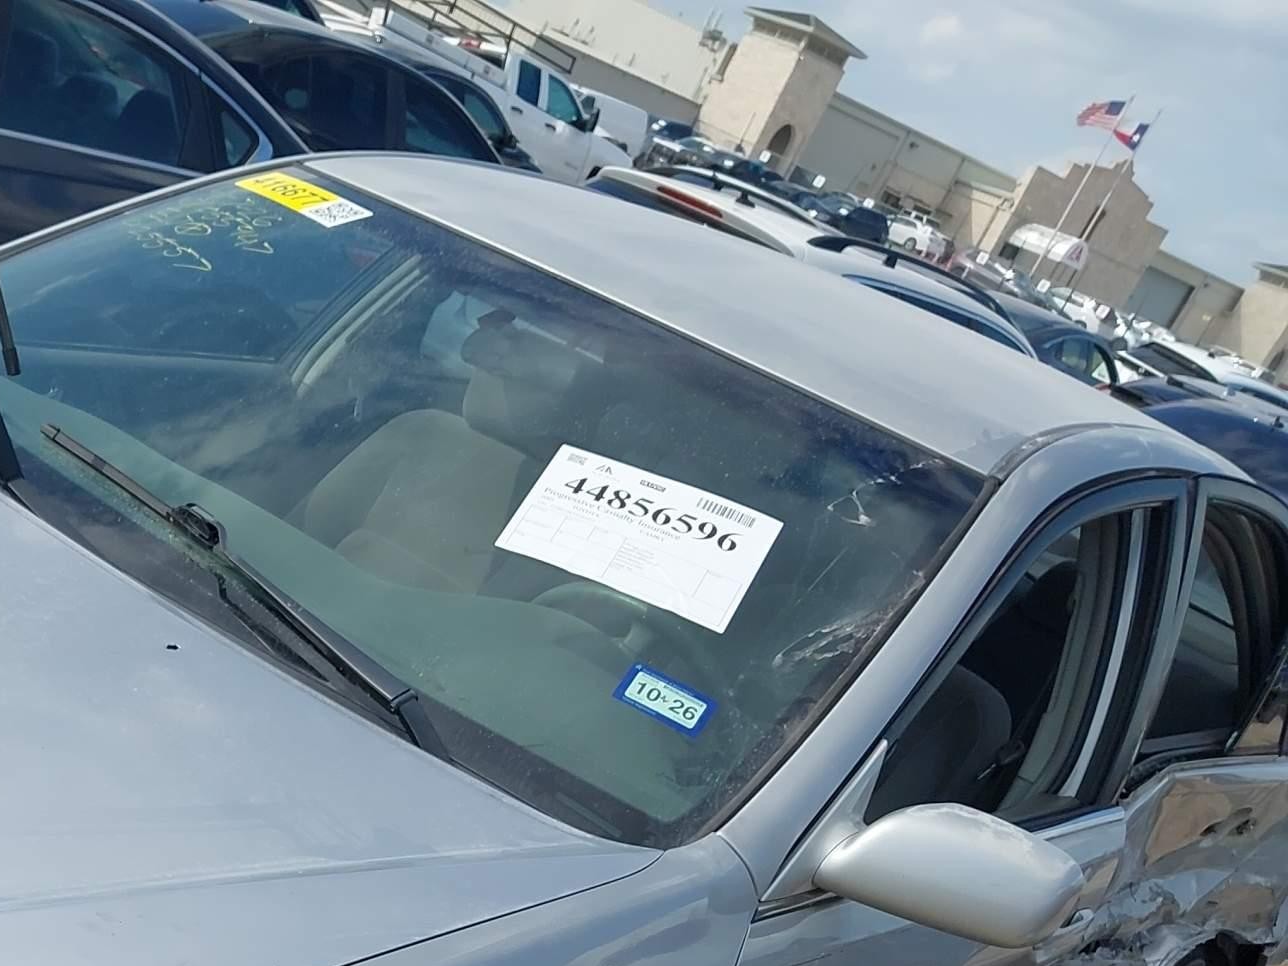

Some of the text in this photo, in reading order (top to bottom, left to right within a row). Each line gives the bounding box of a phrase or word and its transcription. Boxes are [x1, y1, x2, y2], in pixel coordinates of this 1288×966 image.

[564, 477, 744, 552] 44856596
[636, 681, 662, 702] 10
[668, 699, 698, 720] 26
